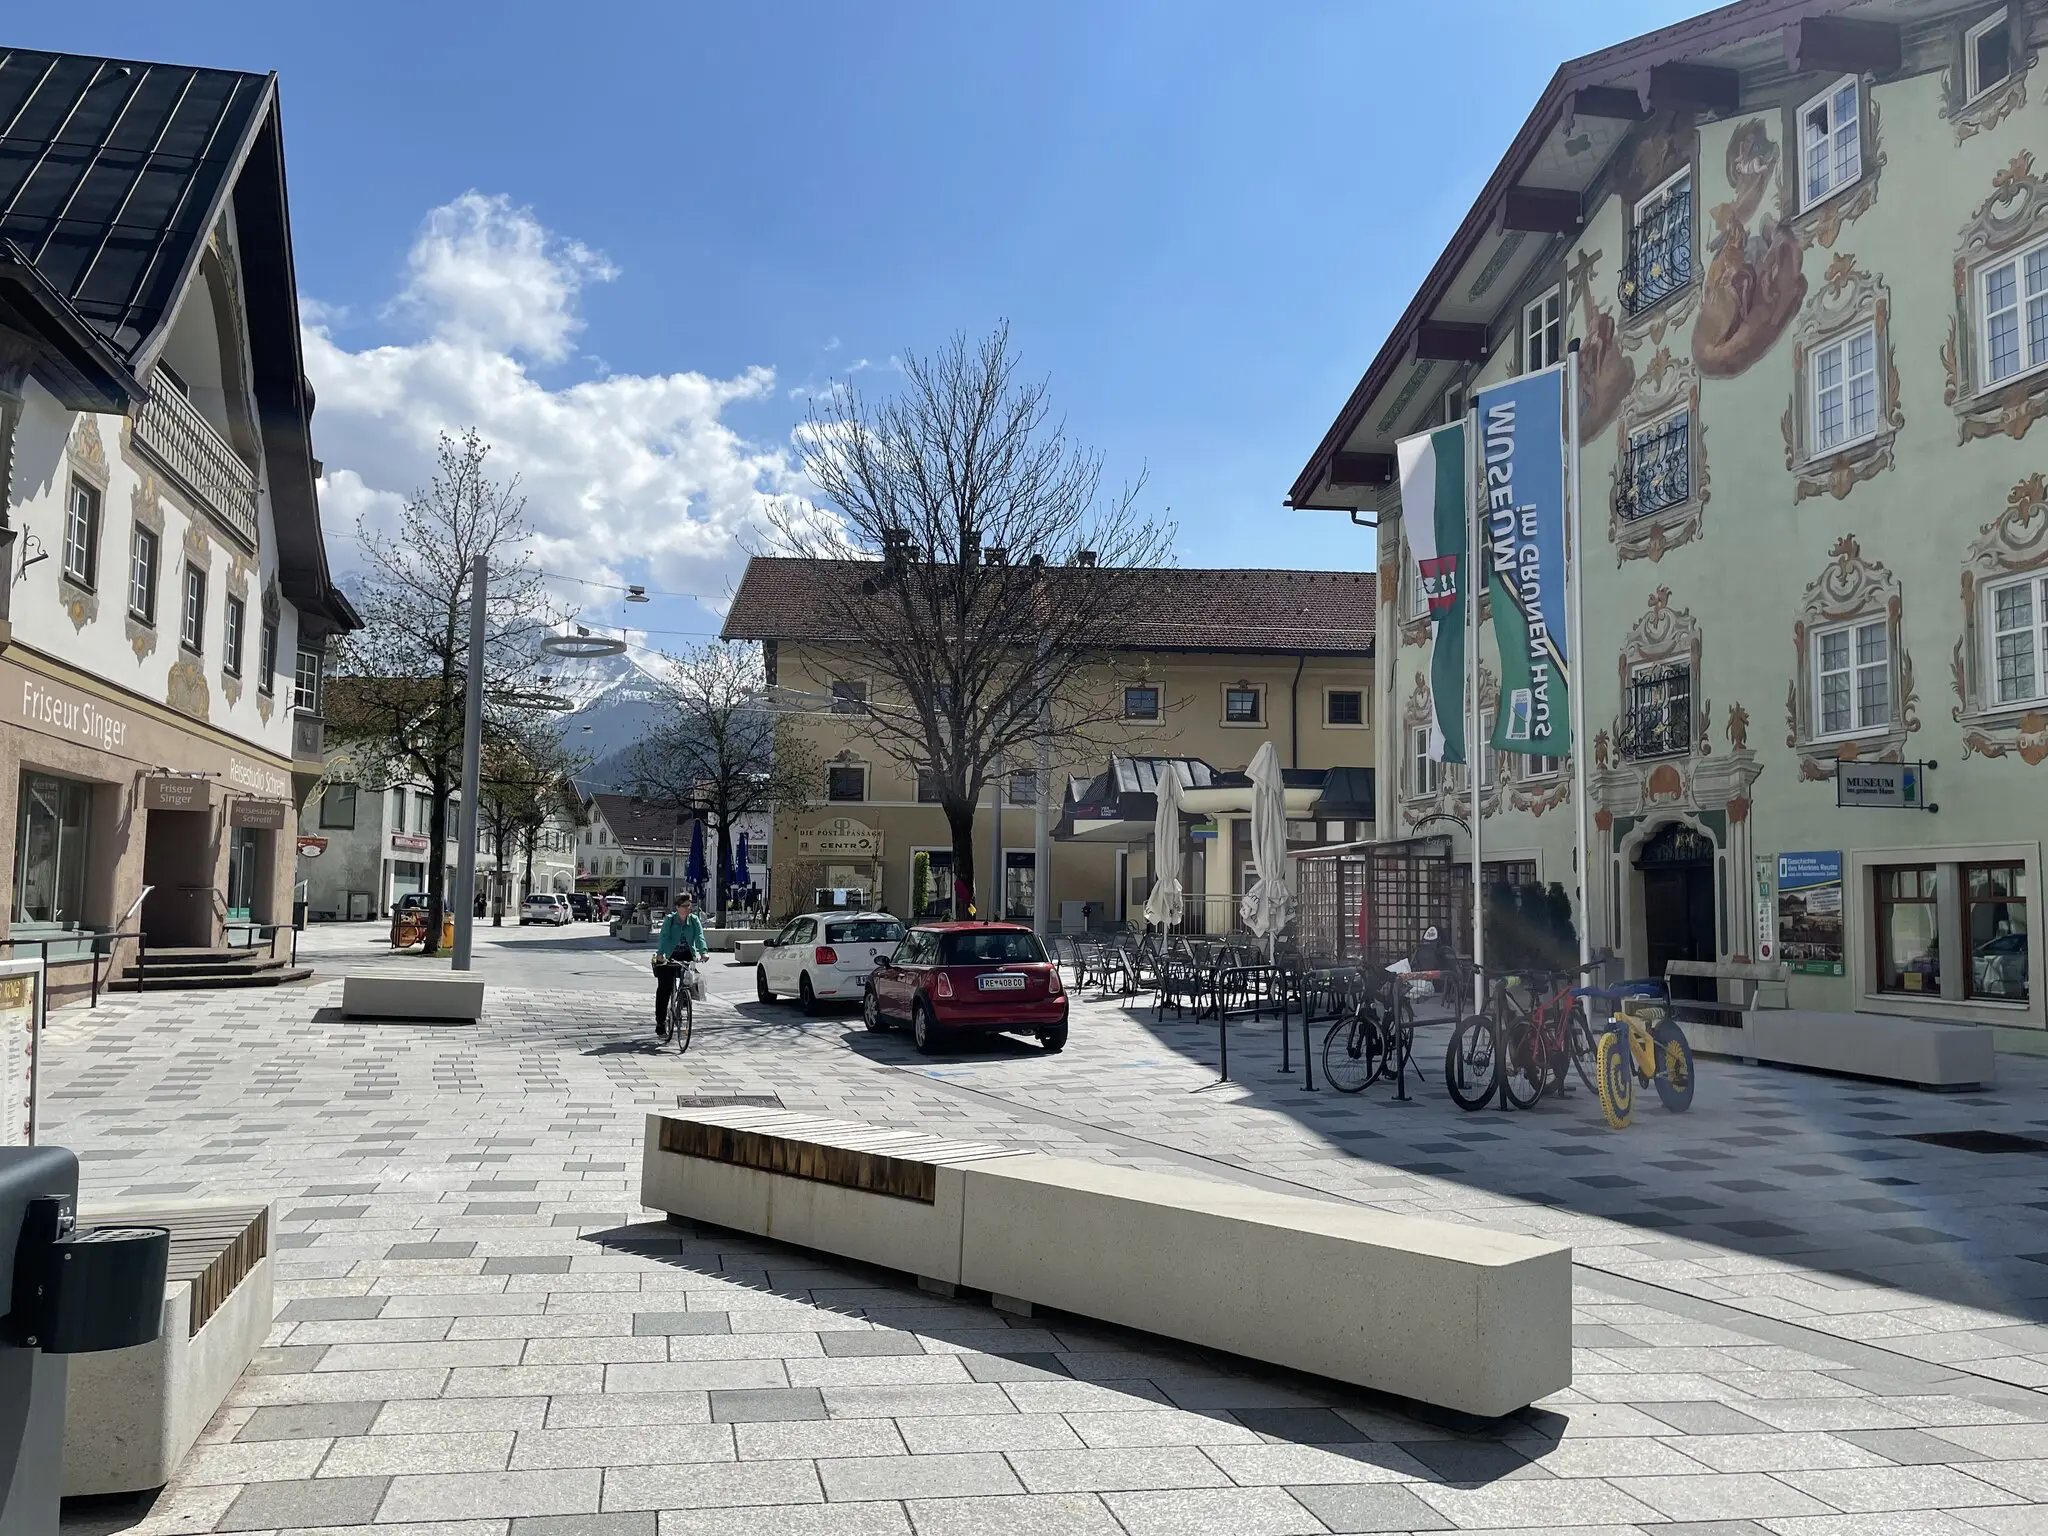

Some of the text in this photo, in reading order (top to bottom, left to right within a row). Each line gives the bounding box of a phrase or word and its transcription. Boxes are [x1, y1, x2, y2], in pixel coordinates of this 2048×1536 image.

[23, 681, 127, 750] Friseur Singer
[1846, 777, 1894, 788] MUSEUM
[160, 783, 194, 794] Friseur
[160, 794, 192, 806] Singer
[985, 979, 995, 988] RE
